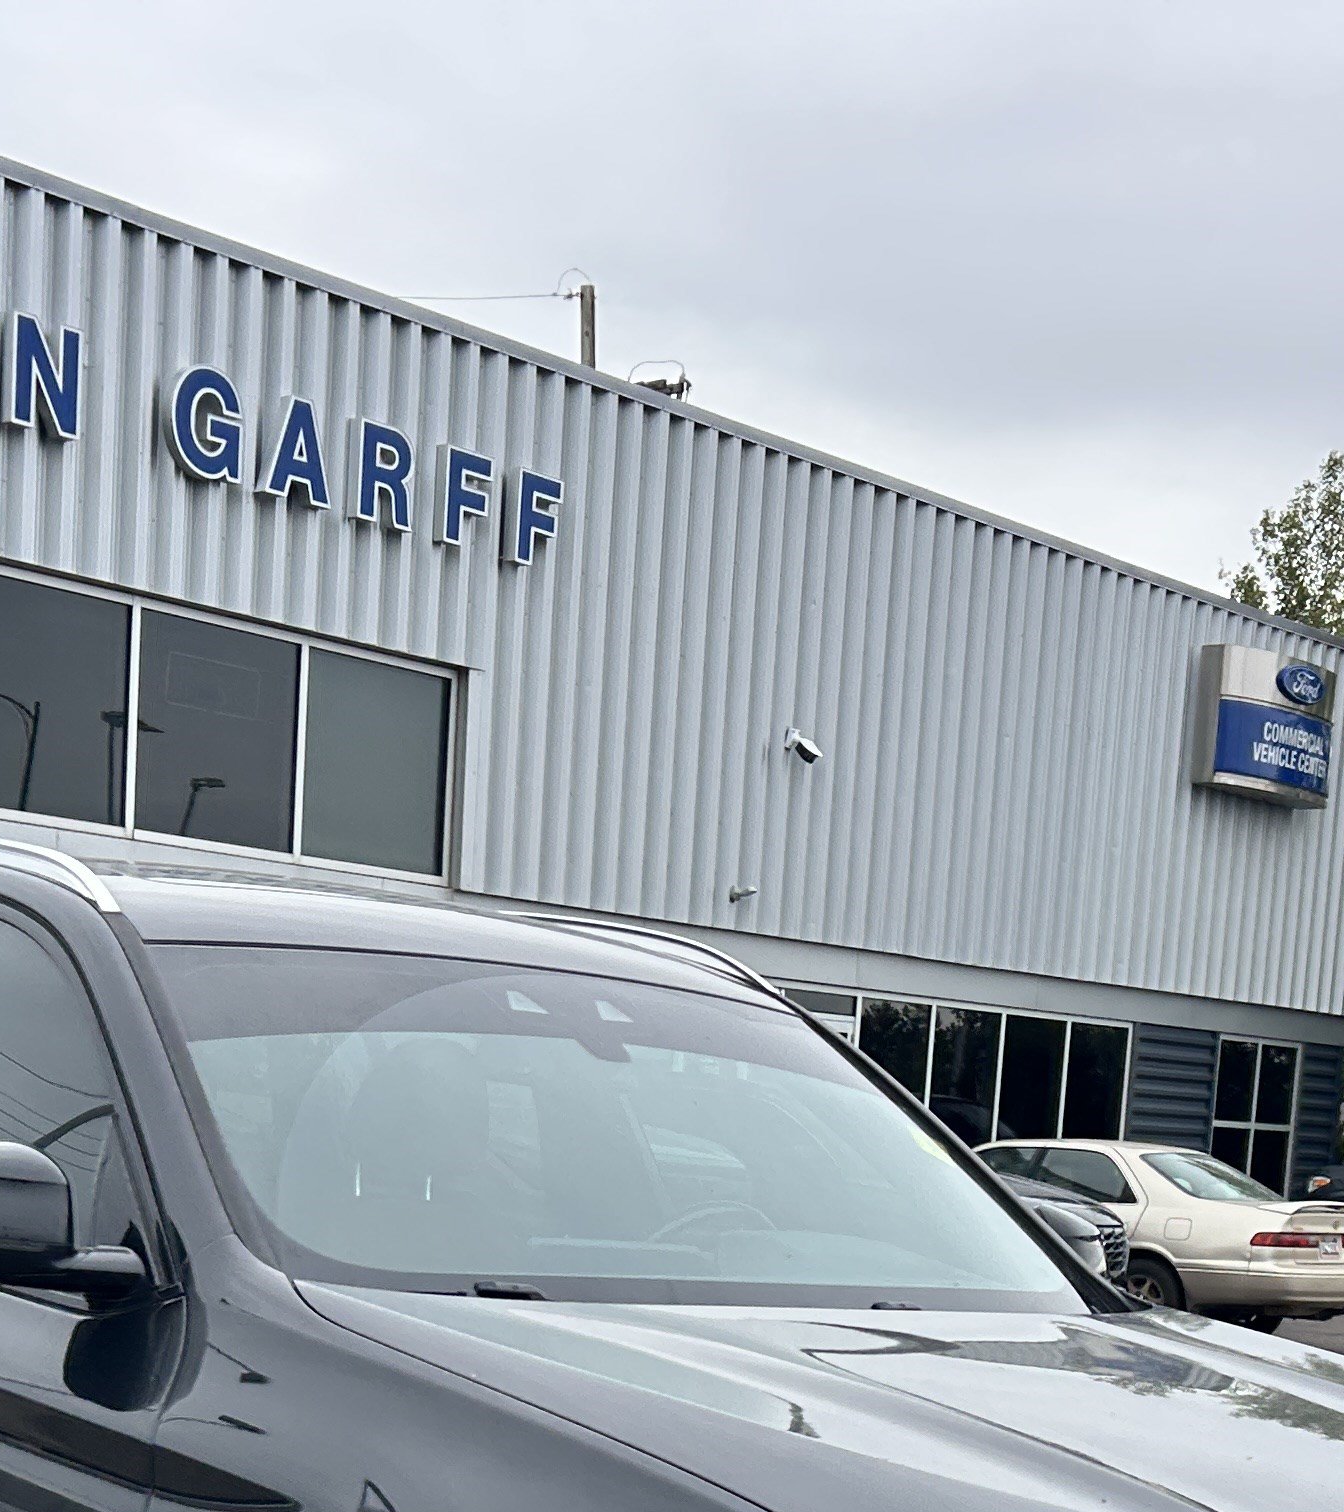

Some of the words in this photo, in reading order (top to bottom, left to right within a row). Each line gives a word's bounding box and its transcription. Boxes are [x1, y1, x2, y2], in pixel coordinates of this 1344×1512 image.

[166, 365, 564, 566] GARFF
[1293, 671, 1321, 701] Ford
[1263, 721, 1324, 756] COMMERCIAL
[1253, 742, 1297, 769] VEHICLE
[1298, 753, 1327, 778] CENTER
